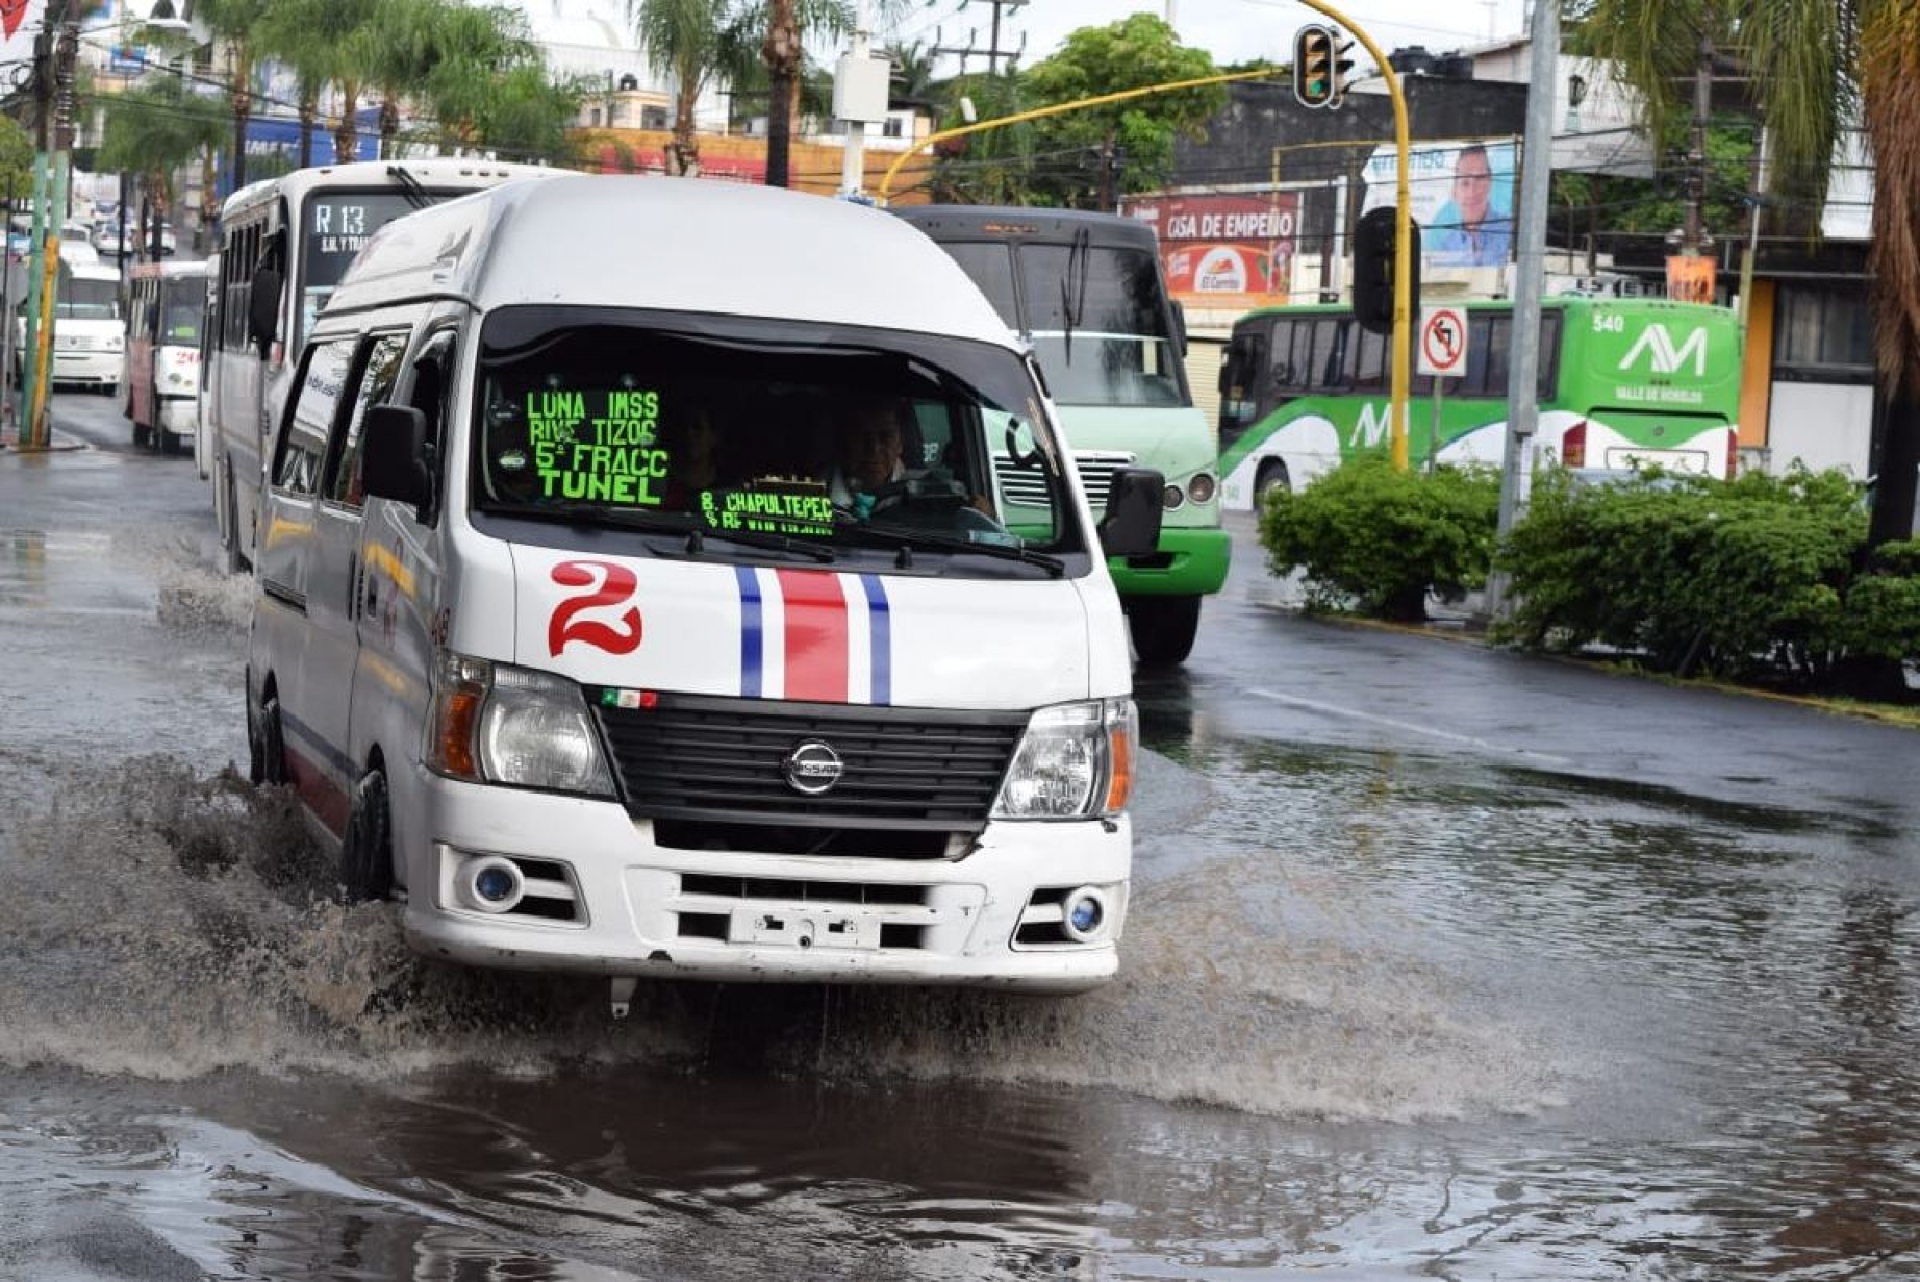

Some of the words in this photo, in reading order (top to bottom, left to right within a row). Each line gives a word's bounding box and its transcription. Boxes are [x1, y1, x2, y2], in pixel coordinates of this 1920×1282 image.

[316, 204, 331, 233] R
[341, 205, 364, 234] 13
[1202, 213, 1221, 237] DE
[1592, 315, 1624, 332] 540
[1617, 323, 1708, 377] AM
[527, 391, 585, 419] LUNA
[608, 391, 659, 419] IMSS
[573, 444, 668, 478] FRACC
[537, 469, 662, 505] TUNEL
[726, 493, 833, 522] CHAPULTEPEC
[548, 559, 643, 658] 2
